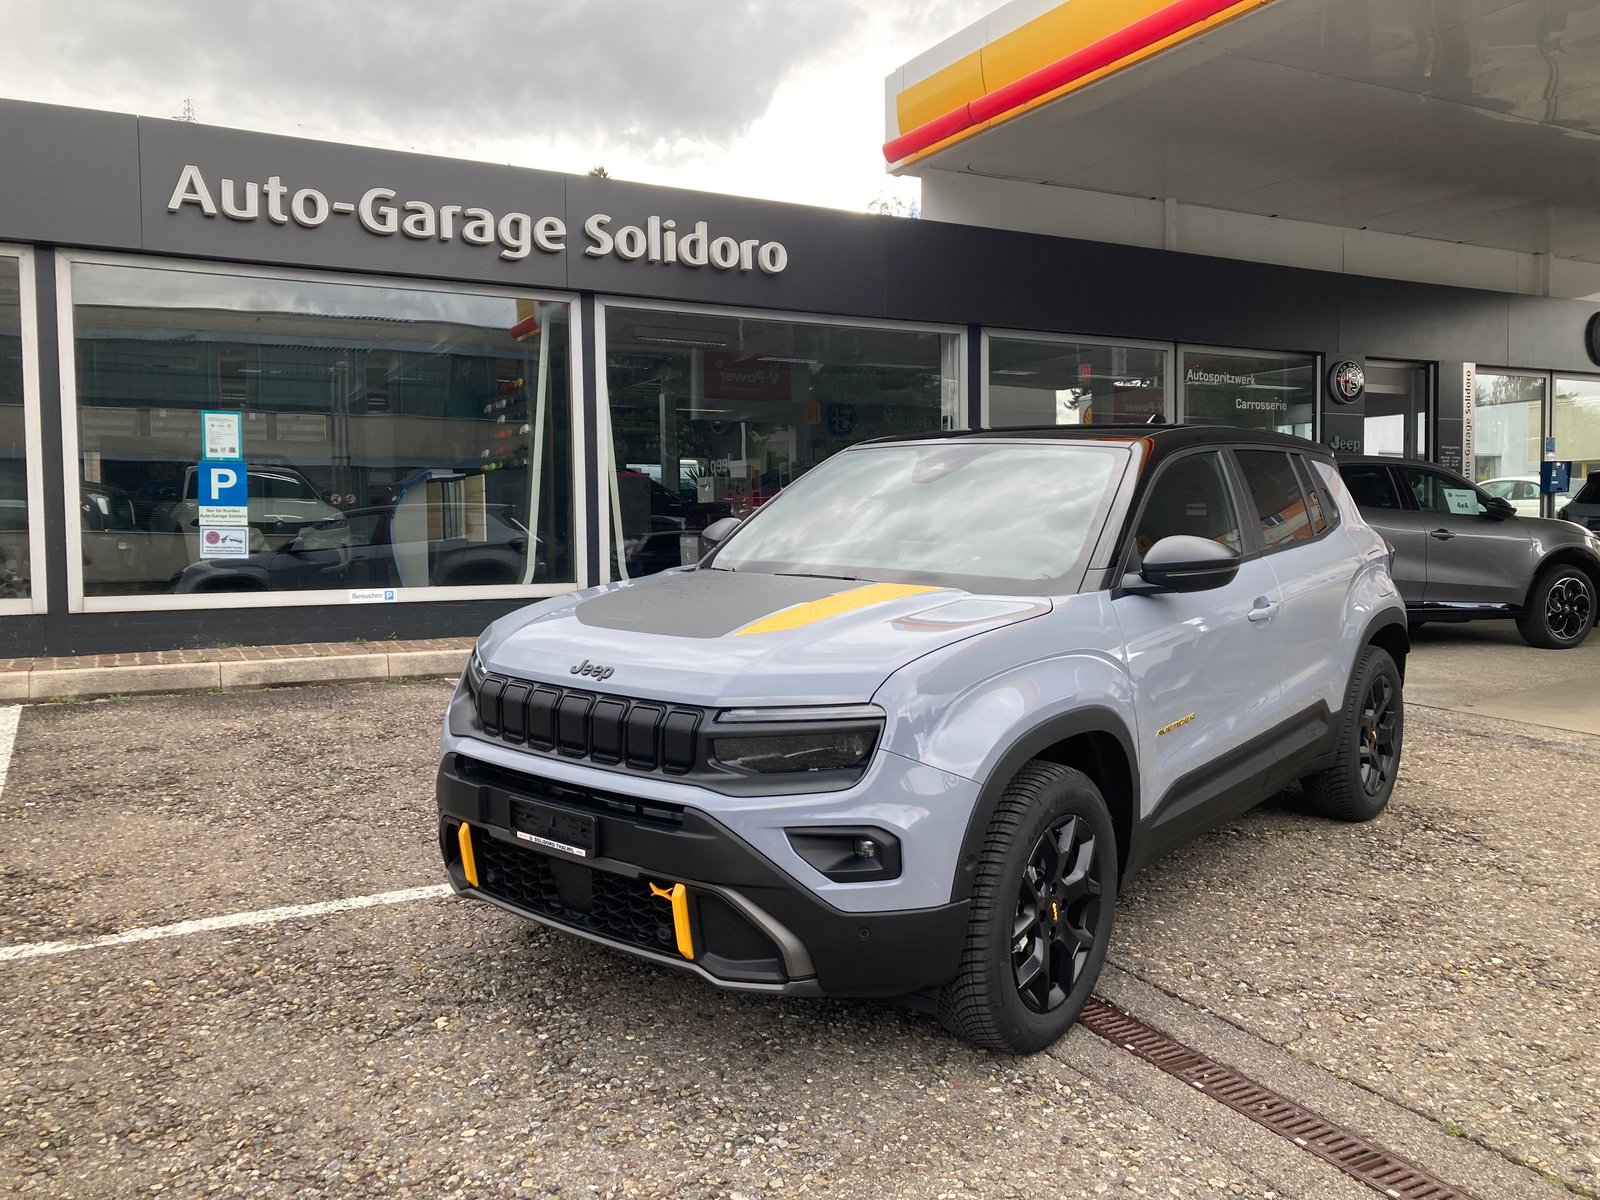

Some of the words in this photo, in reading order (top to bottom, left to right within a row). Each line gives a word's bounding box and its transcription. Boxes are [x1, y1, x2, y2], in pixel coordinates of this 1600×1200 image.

[168, 164, 567, 260] Auto-Garage
[584, 213, 788, 274] Solidoro
[1186, 368, 1256, 385] Autospritzwerk
[1464, 370, 1472, 414] Solidoro
[1235, 398, 1288, 411] Carrosserie
[1329, 435, 1361, 453] Jeep
[1464, 417, 1473, 479] uto-Garage
[210, 468, 237, 500] P
[351, 592, 383, 600] Besucher
[569, 659, 616, 681] Jeep
